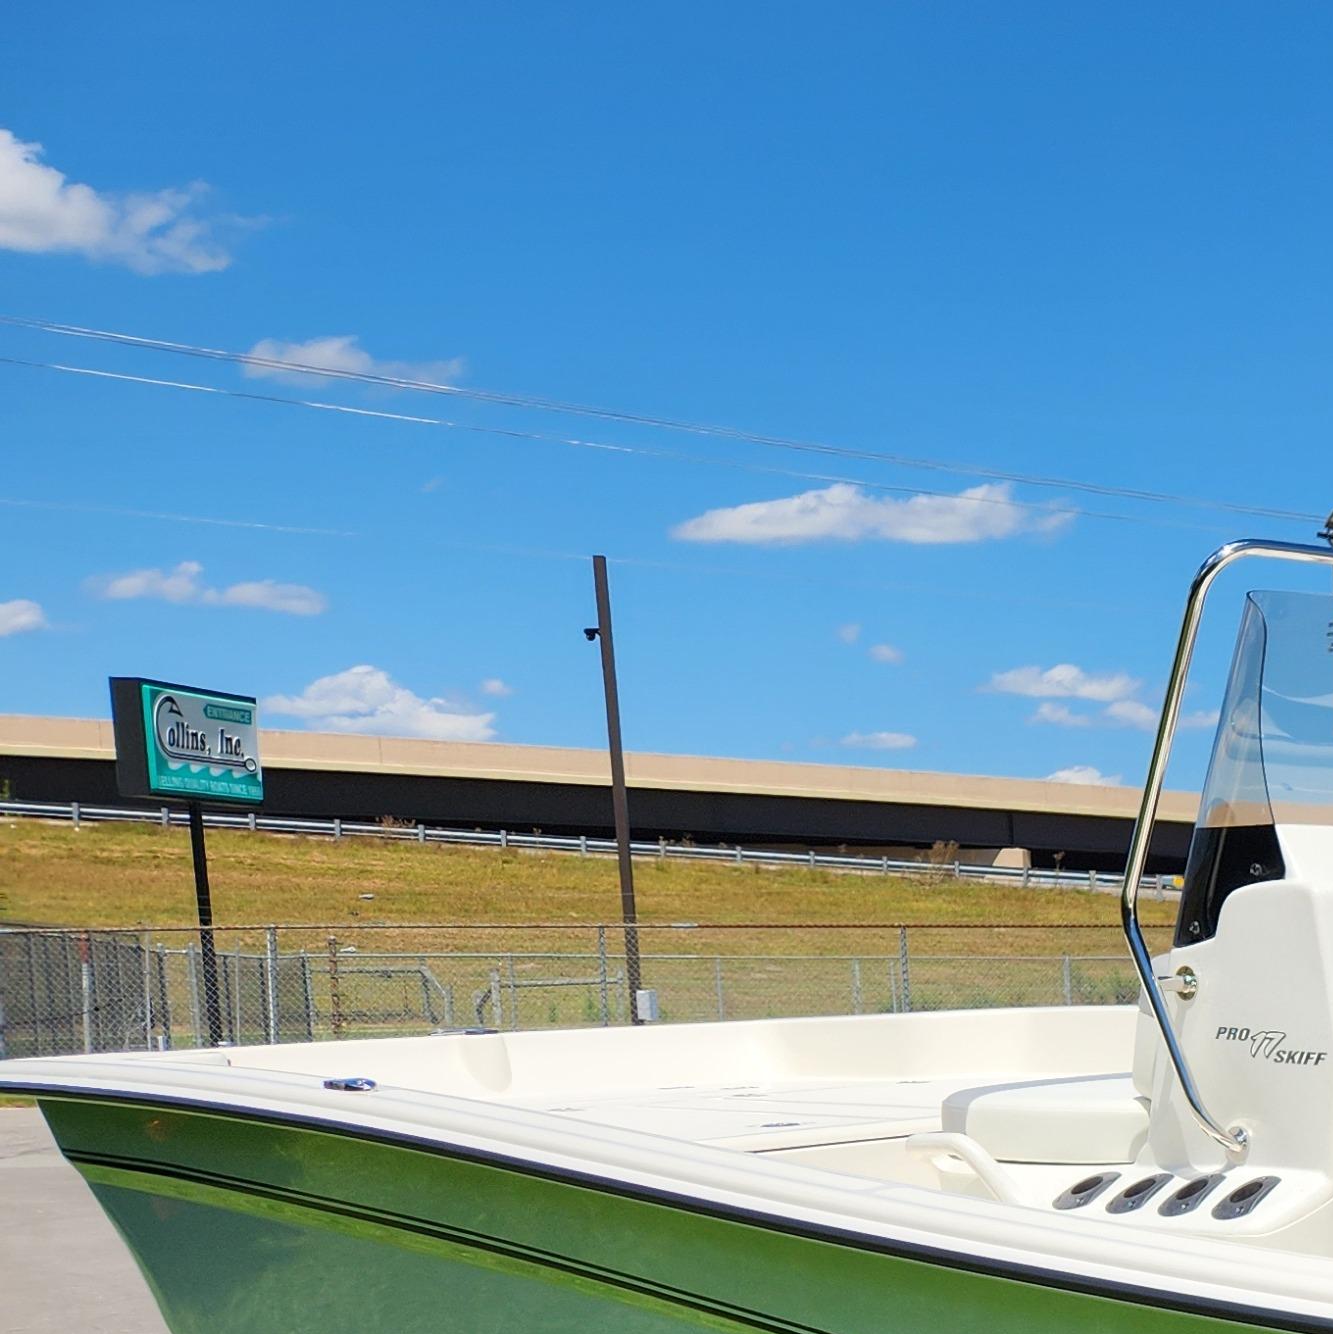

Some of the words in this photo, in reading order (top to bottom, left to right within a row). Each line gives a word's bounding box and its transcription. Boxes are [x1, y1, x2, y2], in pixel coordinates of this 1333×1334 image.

[218, 727, 244, 758] Inc.
[1215, 1026, 1250, 1042] PRO
[1250, 1030, 1286, 1059] 17
[1273, 1050, 1327, 1066] SKIFF
